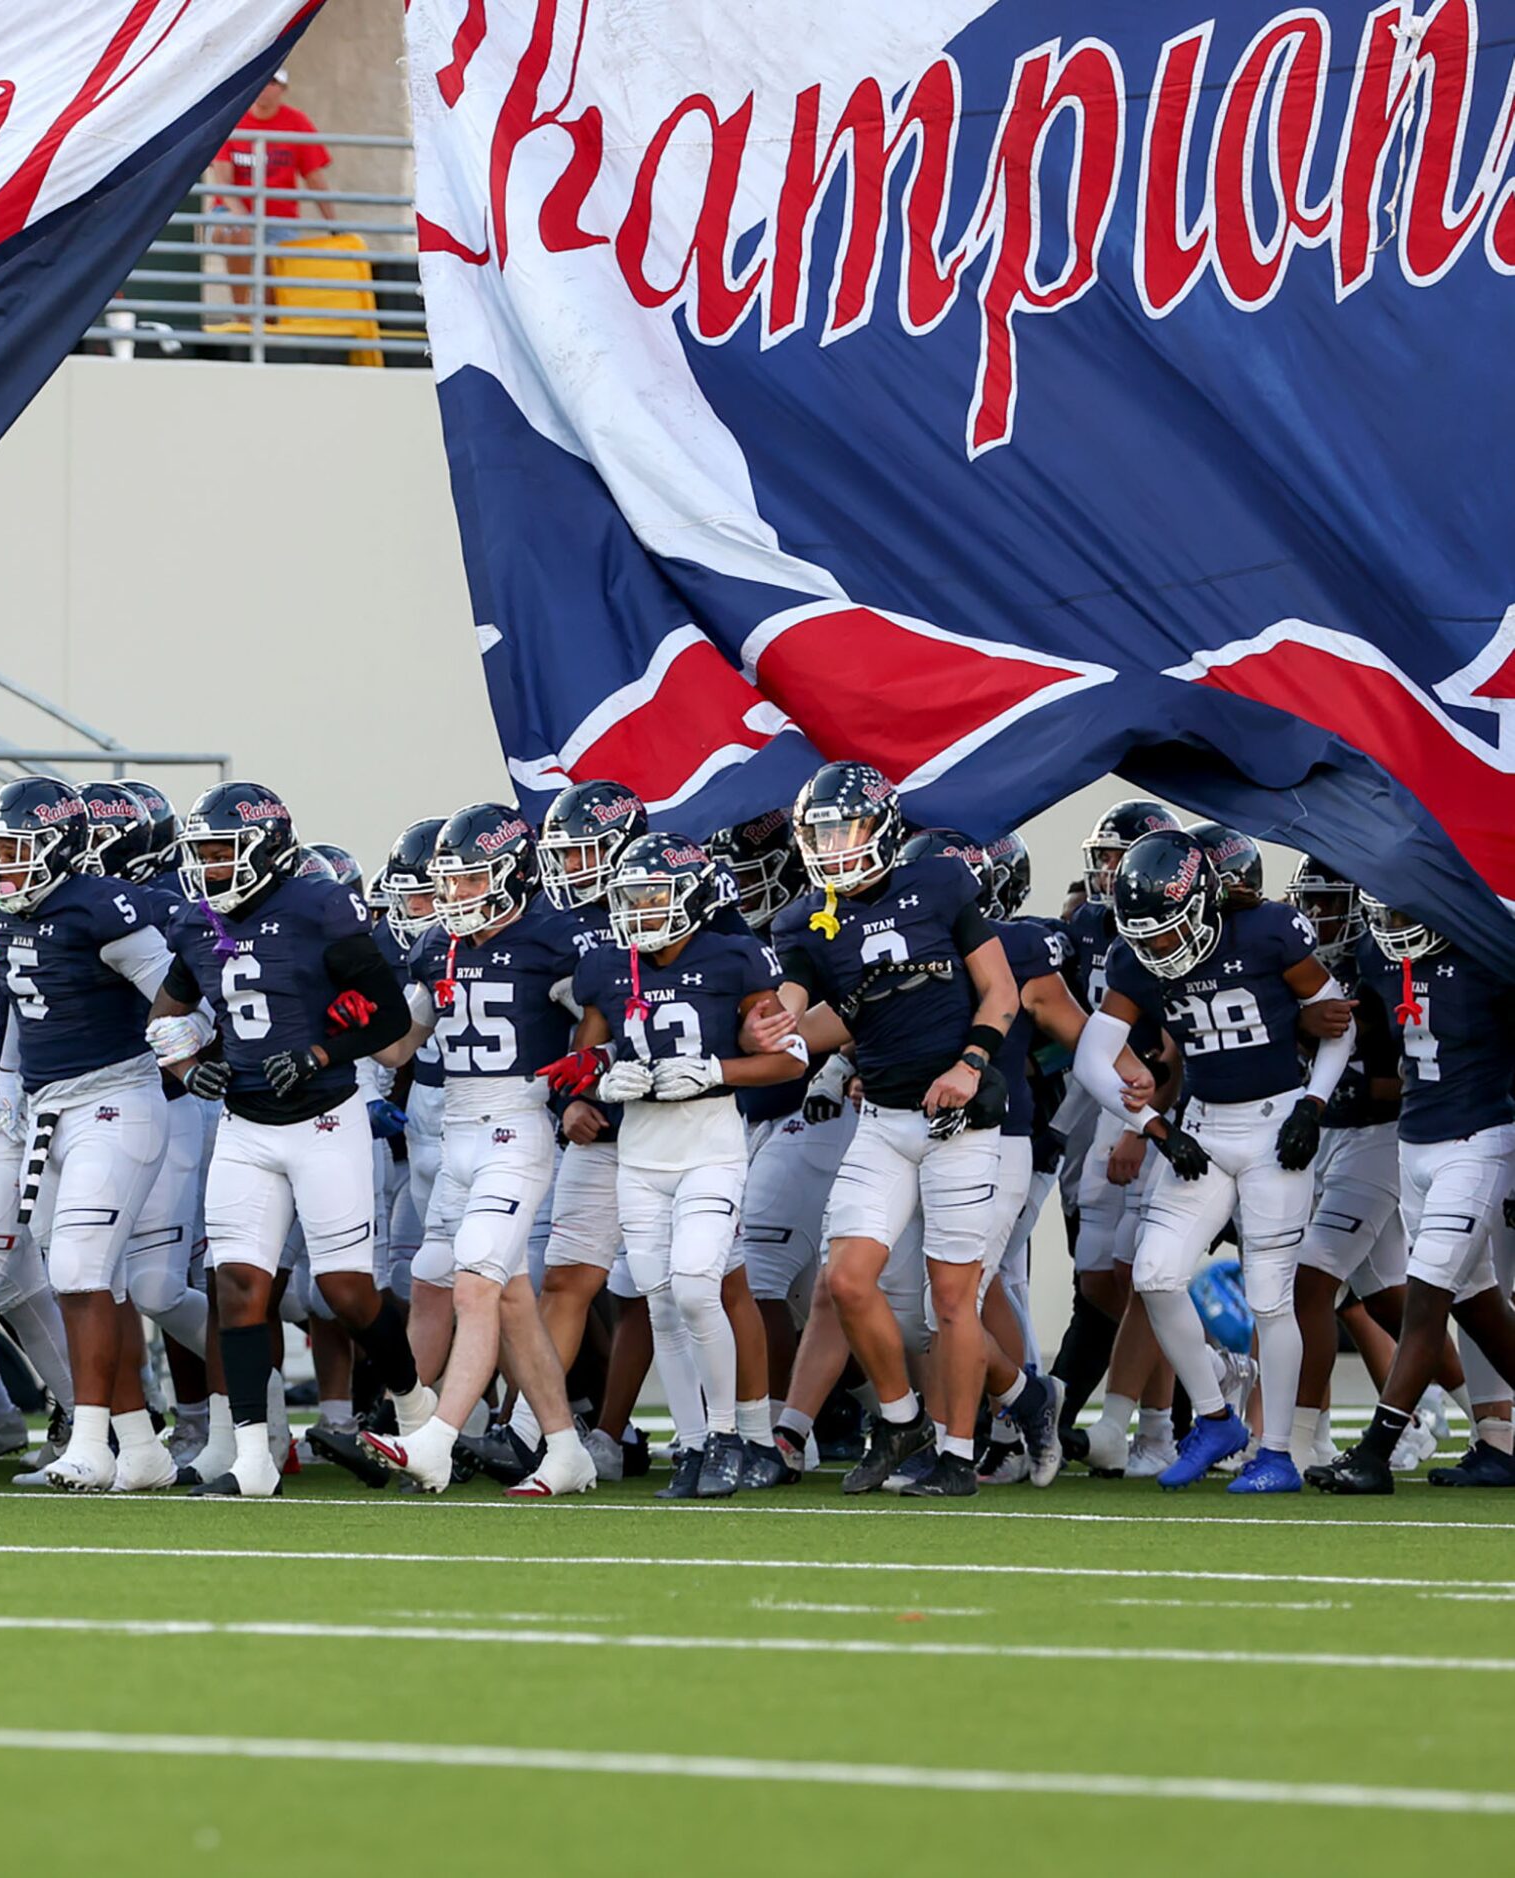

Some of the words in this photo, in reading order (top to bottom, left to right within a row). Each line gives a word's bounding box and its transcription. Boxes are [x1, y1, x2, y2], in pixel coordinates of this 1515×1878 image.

[416, 0, 1515, 462] hampion
[113, 893, 137, 924] 5
[348, 893, 367, 922] 6
[12, 936, 34, 948] RYAN
[863, 918, 895, 936] RYAN
[6, 946, 50, 1020] 5
[456, 967, 484, 979] RYAN
[1187, 979, 1219, 993] RYAN
[222, 954, 272, 1040] 6
[644, 989, 676, 1002] RYAN
[434, 981, 518, 1072] 25
[624, 1001, 703, 1066] 13
